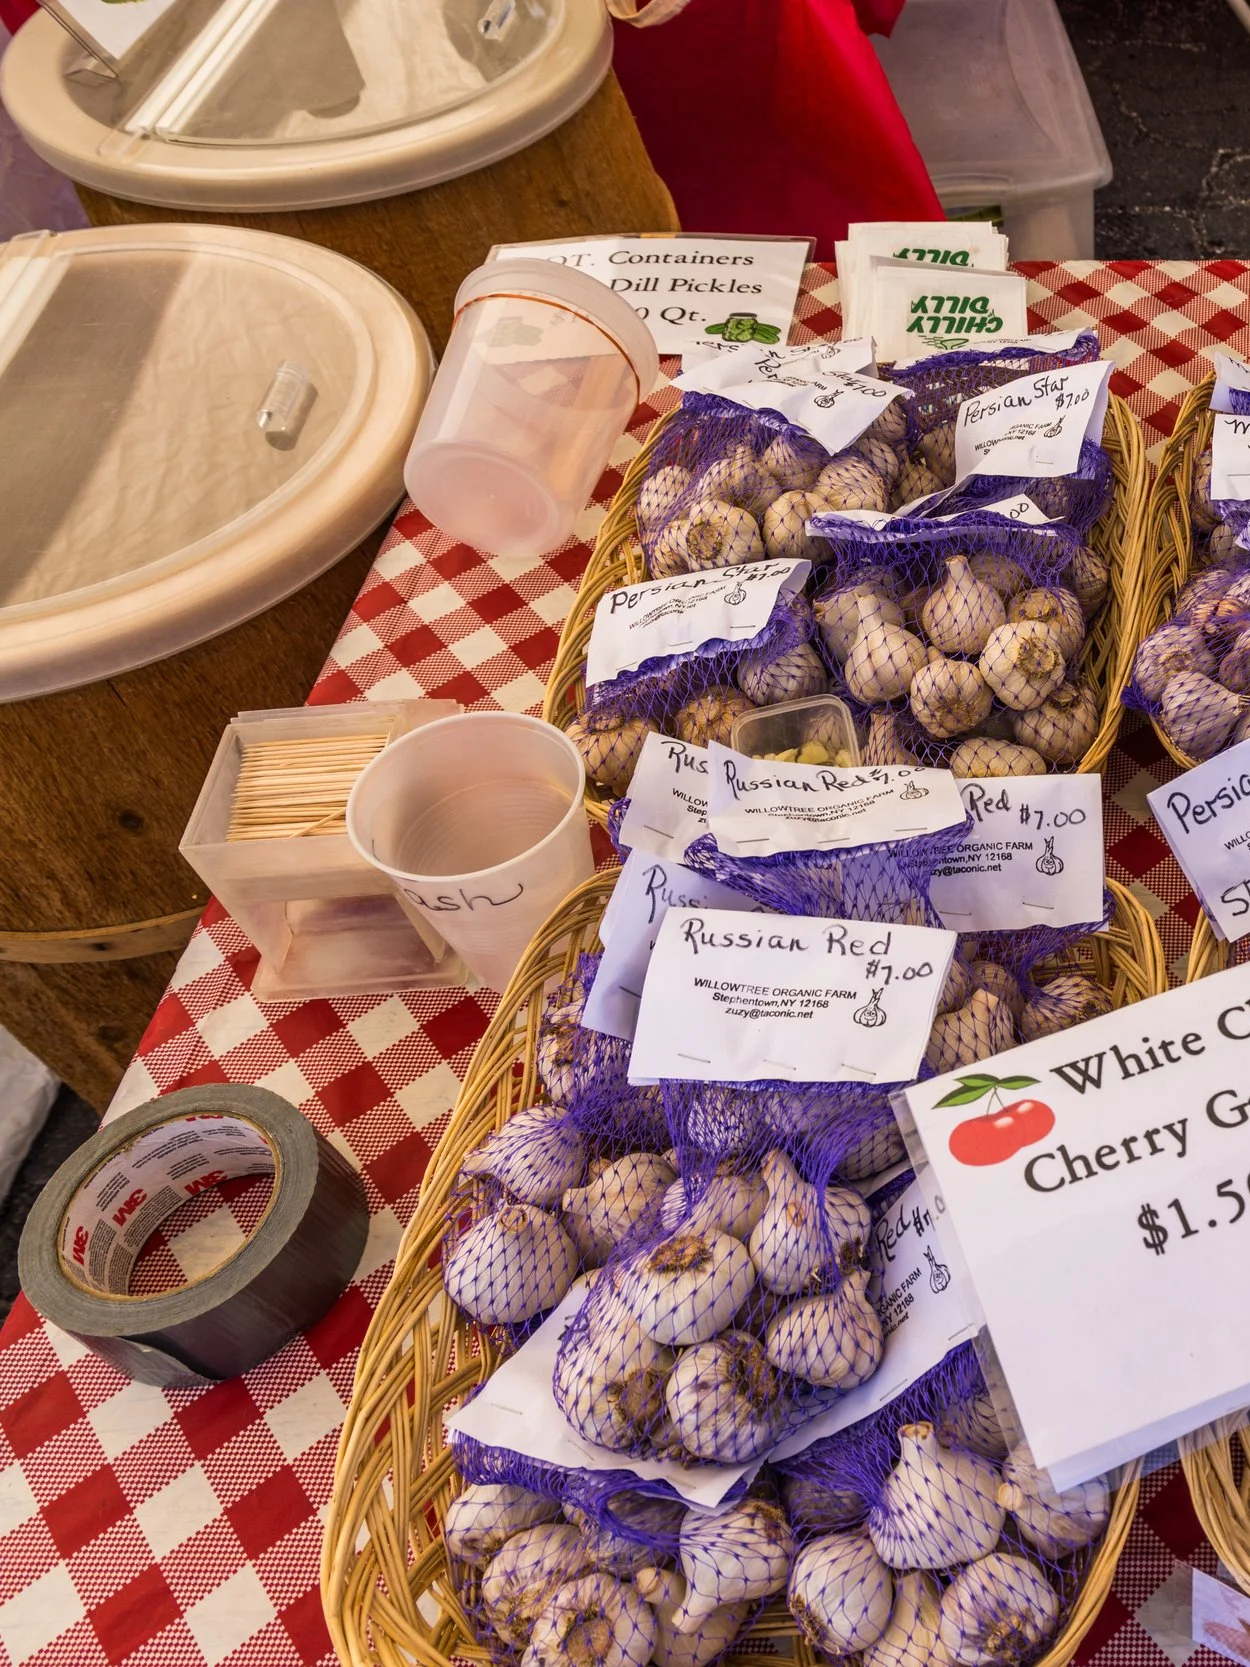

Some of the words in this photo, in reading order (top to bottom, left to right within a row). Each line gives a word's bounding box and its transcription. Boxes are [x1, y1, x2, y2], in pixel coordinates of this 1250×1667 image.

[608, 250, 755, 267] Containers
[610, 278, 659, 294] Dill
[667, 278, 763, 295] Pickles
[659, 306, 707, 325] Qt.
[910, 296, 990, 314] DILLY
[906, 315, 1004, 334] CHILLY
[964, 395, 1032, 427] Persian
[1033, 376, 1069, 399] Star
[1056, 387, 1090, 411] $7.00
[723, 562, 780, 582] Star
[745, 566, 791, 582] $7.00
[610, 578, 712, 614] Persian
[724, 760, 815, 801] Russian
[817, 770, 866, 792] Red
[868, 766, 927, 785] $7.00
[744, 805, 815, 815] WILLOWTREE
[817, 798, 864, 813] ORGANIC
[866, 789, 895, 802] FARM
[961, 783, 1011, 822] Red
[1019, 804, 1087, 830] $7.00
[956, 843, 1003, 853] ORGANIC
[1005, 842, 1034, 851] FARM
[985, 853, 1013, 862] 12168
[680, 917, 809, 955] Russian
[823, 924, 892, 956] Red
[865, 958, 934, 985] $7.00
[694, 977, 769, 996] WILLOWTREE
[772, 987, 825, 998] ORGANIC
[825, 989, 857, 1000] FARM
[712, 993, 796, 1008] Stephentown,NY
[799, 999, 829, 1009] 12168
[725, 1007, 814, 1020] zuzy@taconic.net
[1050, 1031, 1206, 1096] White
[1022, 1113, 1191, 1195] Cherry
[183, 1170, 228, 1196] 3M
[112, 1188, 148, 1228] 3M
[876, 1203, 911, 1262] Red
[72, 1226, 89, 1266] 3M
[901, 1267, 922, 1293] FARM
[893, 1293, 915, 1314] 12168
